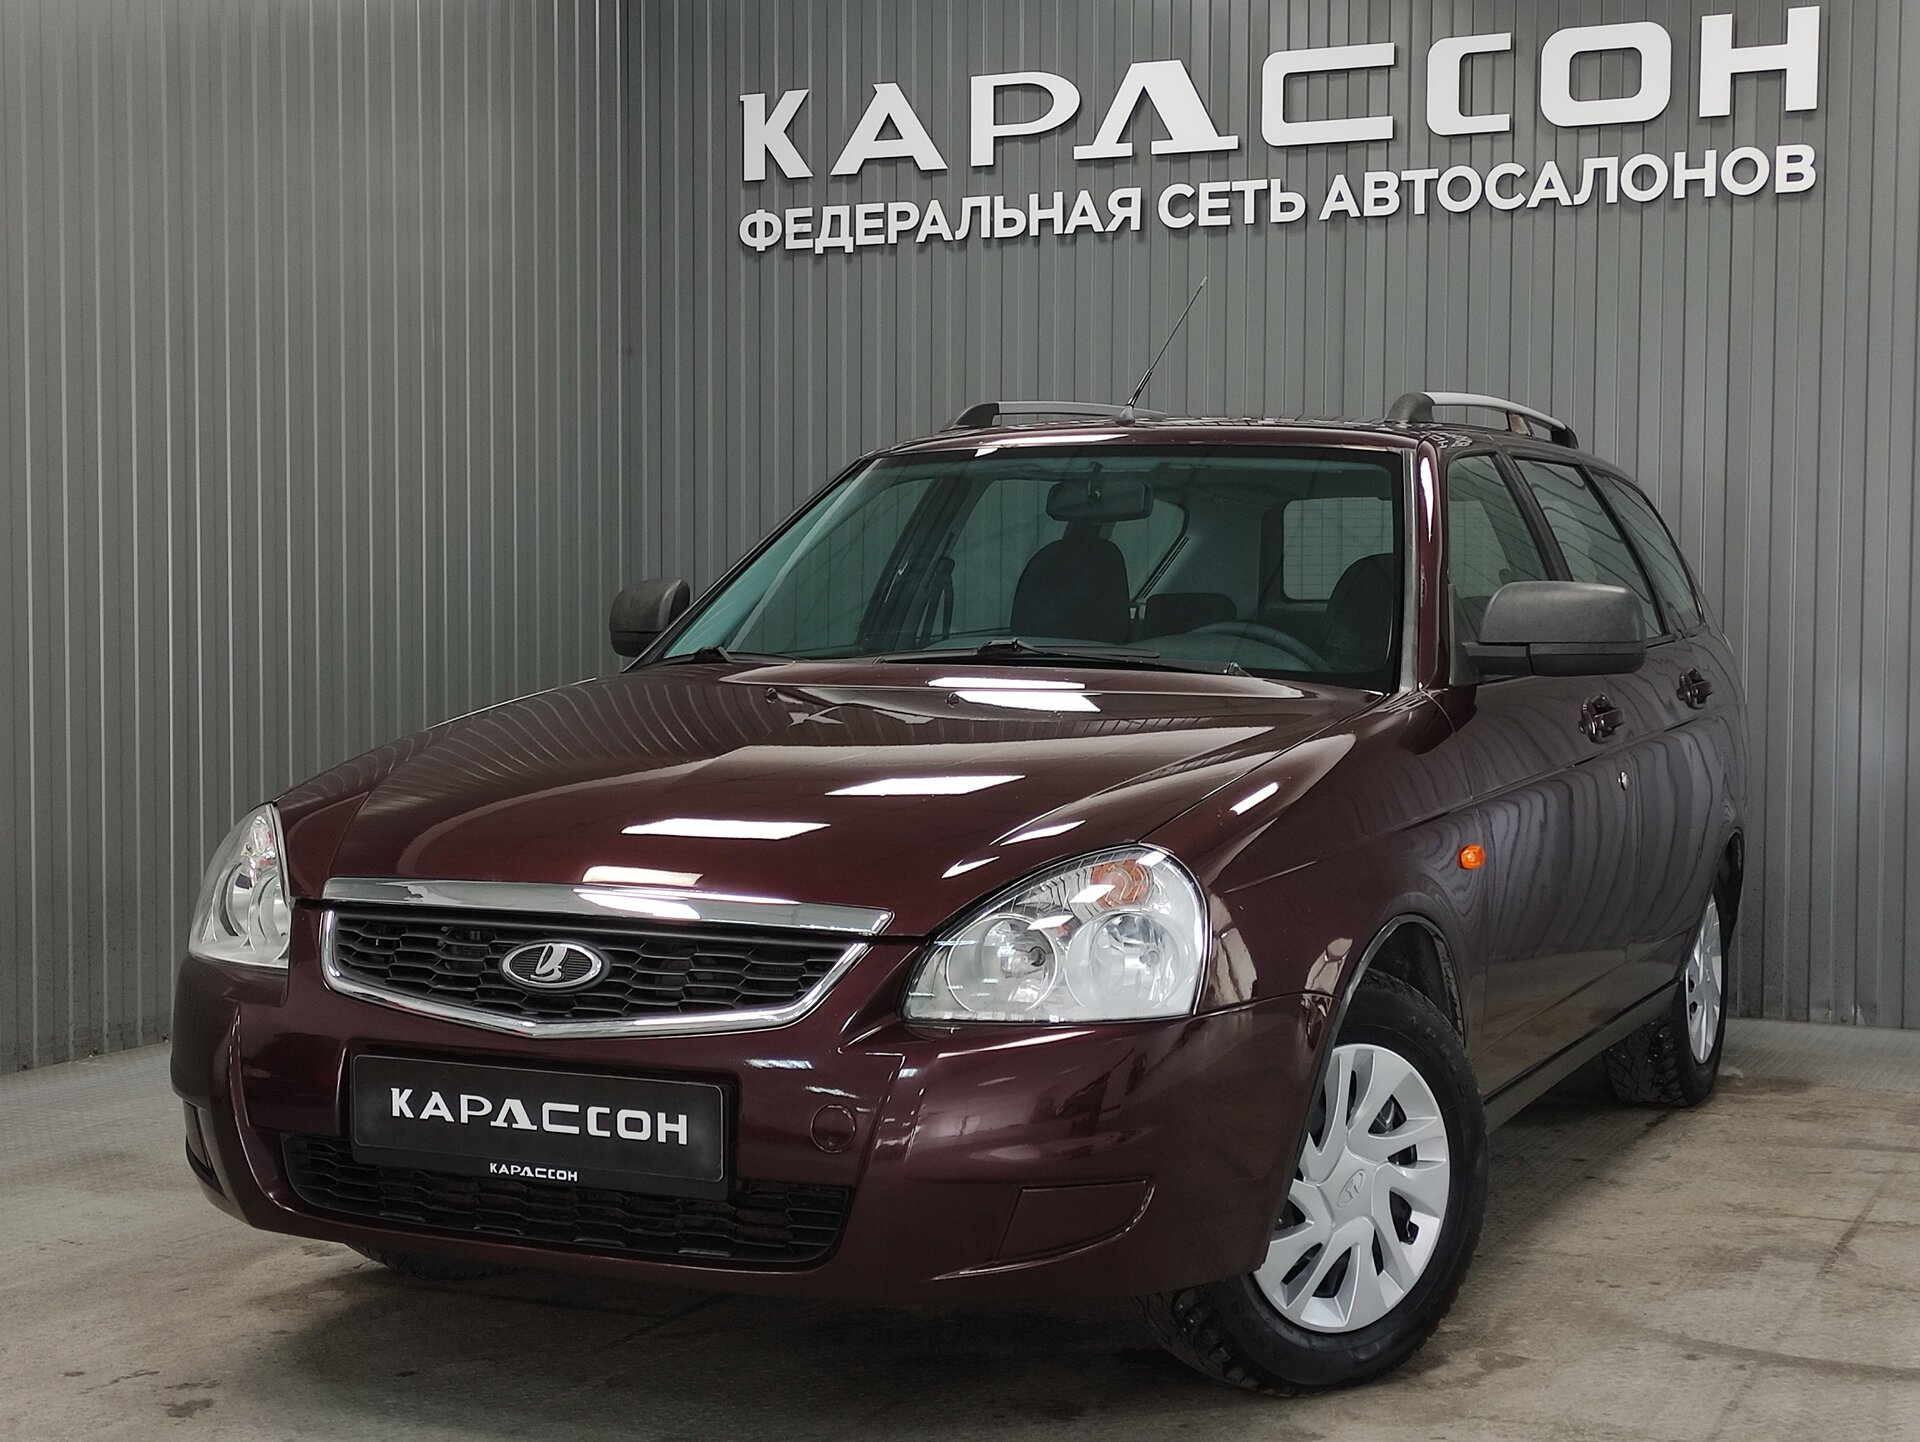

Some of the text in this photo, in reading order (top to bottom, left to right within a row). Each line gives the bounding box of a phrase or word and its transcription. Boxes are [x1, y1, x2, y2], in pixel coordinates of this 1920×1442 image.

[739, 144, 1817, 254] ФЕДЕРАЛЬНАЯ СЕТЬ АВТОСАЛОНОВ
